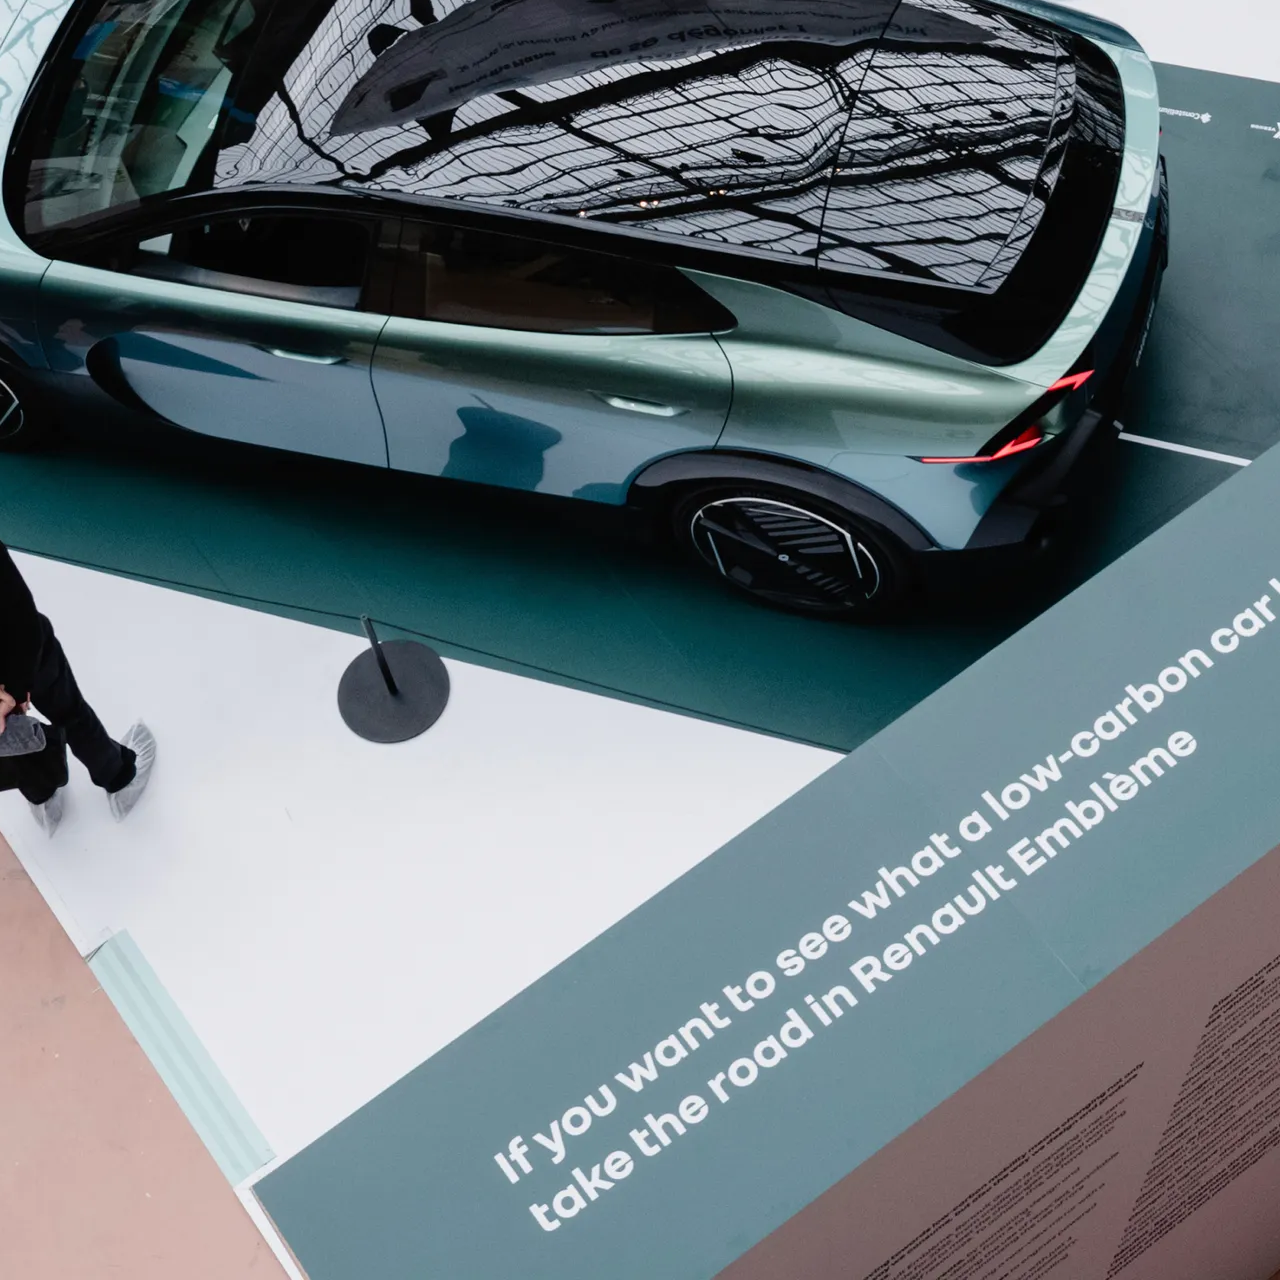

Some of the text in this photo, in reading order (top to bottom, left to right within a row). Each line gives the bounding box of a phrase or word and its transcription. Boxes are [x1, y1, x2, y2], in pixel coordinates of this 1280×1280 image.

[493, 1135, 534, 1185] If
[532, 1084, 617, 1165] you
[614, 1002, 732, 1093] want
[722, 970, 776, 1012] to
[776, 914, 852, 977] see
[847, 832, 962, 920] what
[958, 810, 993, 842] a
[981, 648, 1215, 821] low-carbon
[1210, 594, 1277, 654] car
[528, 730, 1198, 1232] take the road in Renault Emblème
